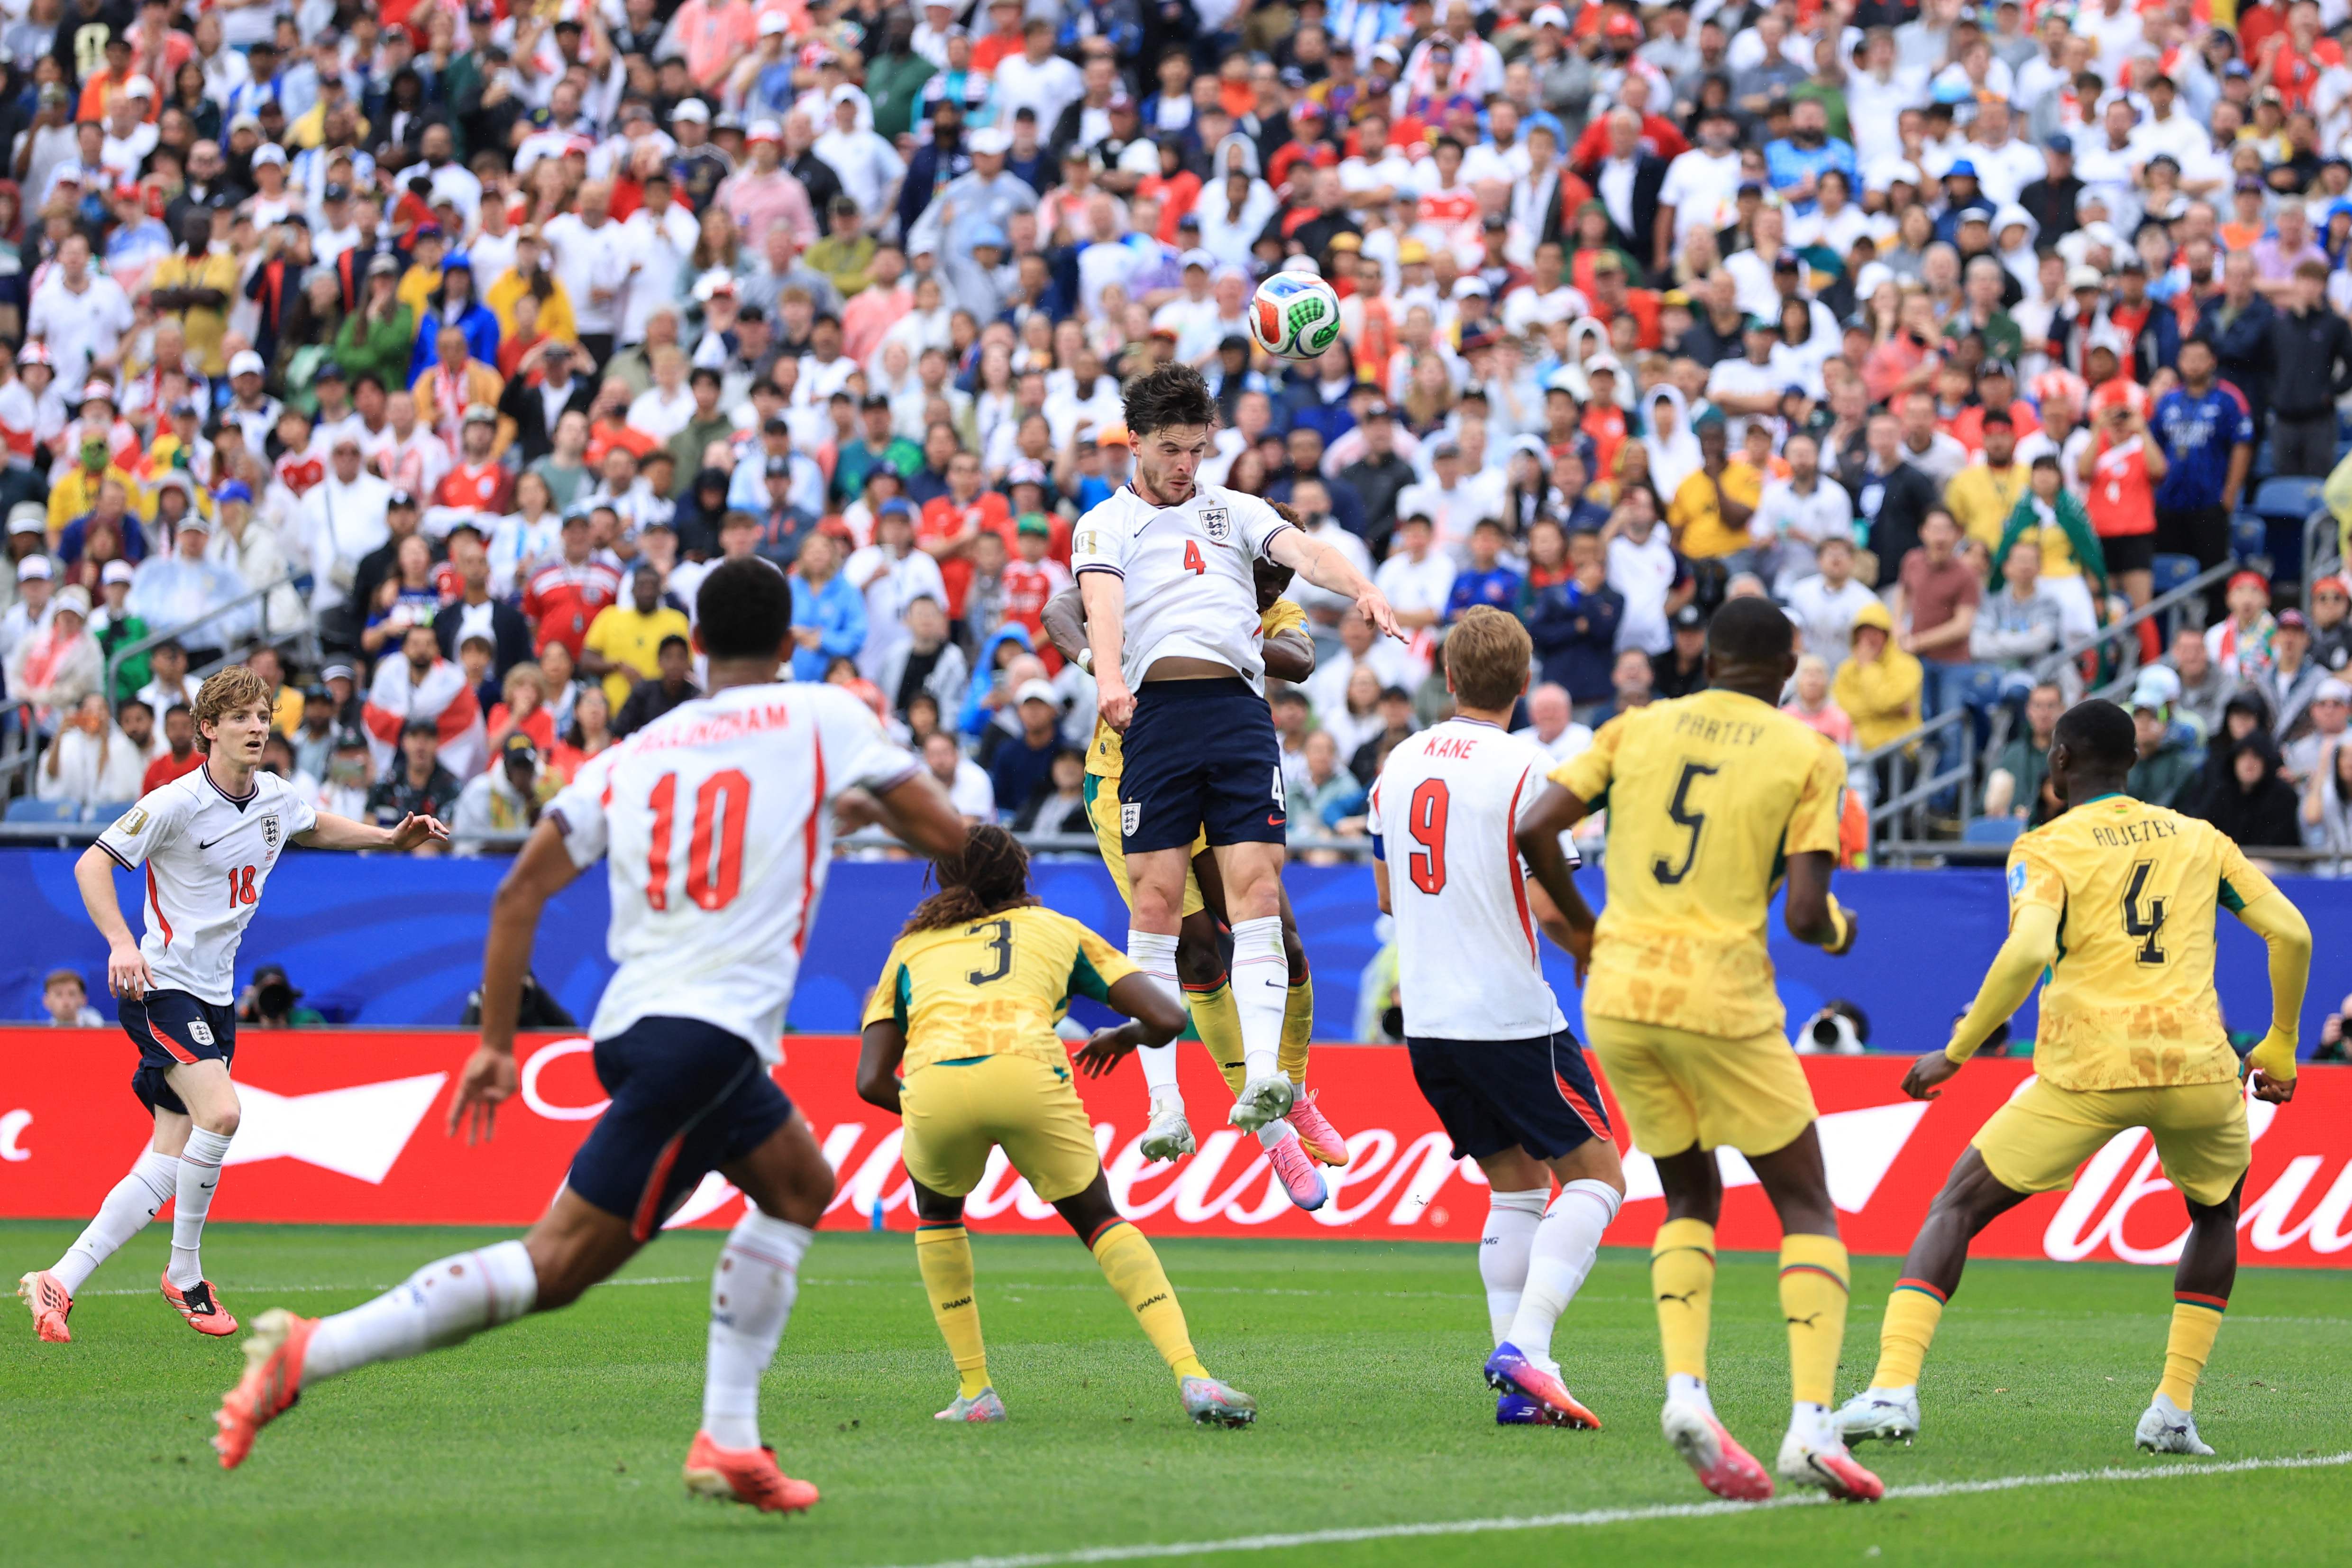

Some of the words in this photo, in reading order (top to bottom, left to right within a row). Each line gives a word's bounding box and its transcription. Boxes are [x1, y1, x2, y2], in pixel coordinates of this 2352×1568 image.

[1184, 540, 1206, 575] 4
[1424, 737, 1478, 760] KANE
[1675, 711, 1766, 746] PARTEY
[1272, 766, 1285, 811] 4
[647, 769, 751, 911] 10
[1409, 778, 1450, 895] 9
[1652, 759, 1720, 886] 5
[2093, 820, 2178, 846] ADJETEY
[229, 865, 256, 908] 18
[2120, 858, 2170, 968] 4
[965, 917, 1017, 988] 3
[942, 1296, 972, 1310] GHANA
[1137, 1293, 1168, 1312] GHANA
